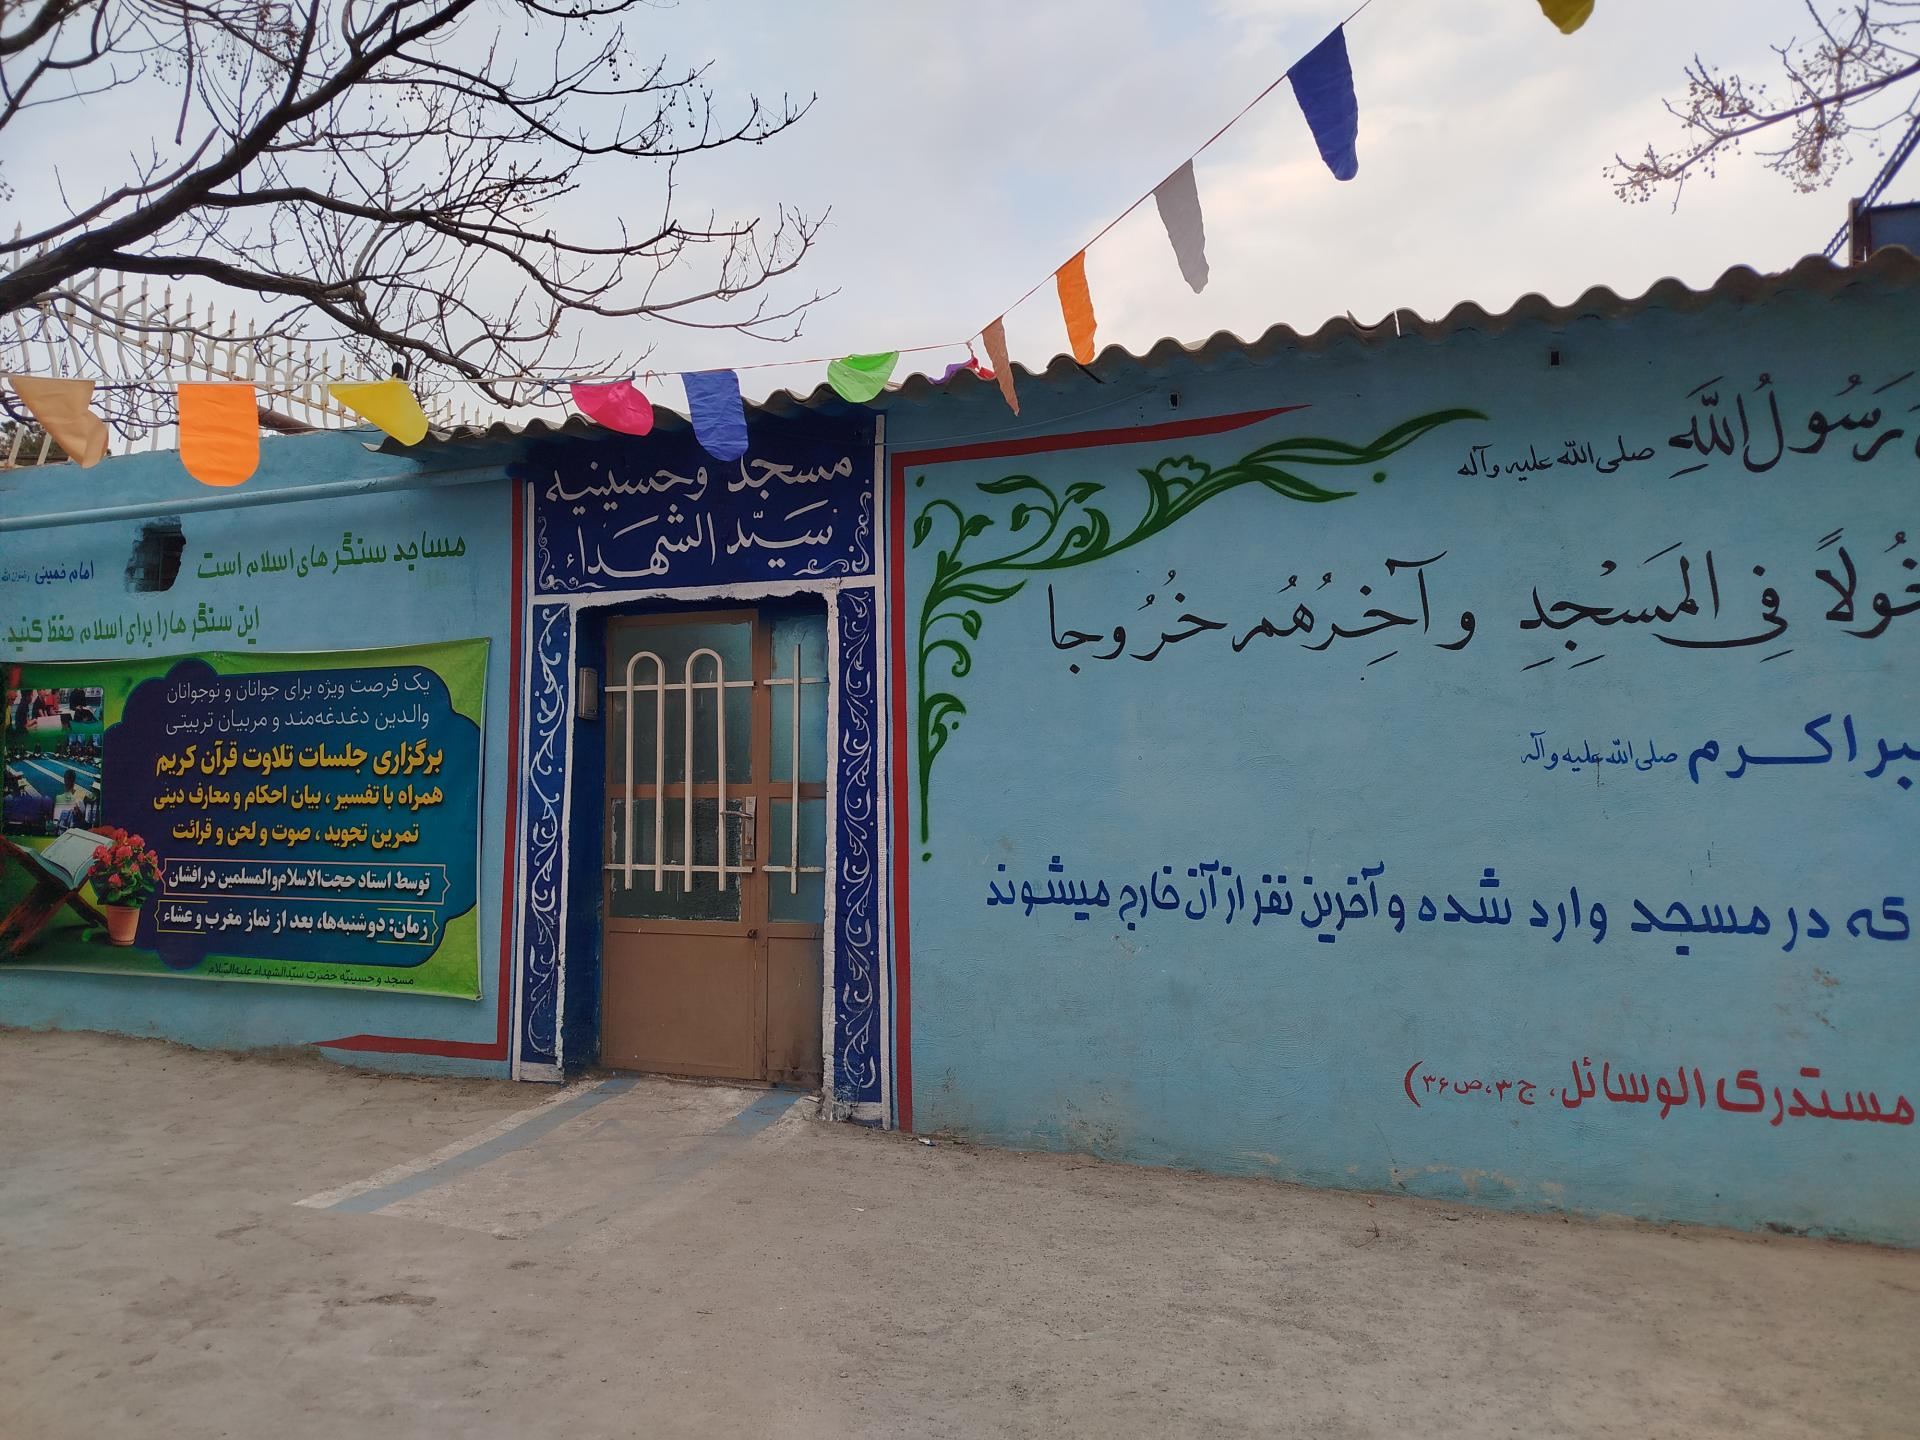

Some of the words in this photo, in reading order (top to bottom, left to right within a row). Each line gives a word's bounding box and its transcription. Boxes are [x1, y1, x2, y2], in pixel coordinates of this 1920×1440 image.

[1504, 444, 1554, 482] علیه
[1596, 434, 1656, 475] صلی
[727, 454, 854, 501] مسجد
[246, 547, 294, 578] اسلام
[393, 530, 466, 573] مساجد
[34, 563, 67, 585] خمینی
[69, 560, 95, 585] امام
[196, 551, 242, 580] است
[47, 613, 76, 644] حفظ
[80, 614, 124, 645] اسلام
[125, 612, 152, 649] برای
[237, 604, 260, 646] این
[166, 682, 221, 705] نوجوانان
[235, 680, 279, 702] جوانان
[284, 677, 312, 701] برای
[317, 683, 345, 702] ویژه
[350, 672, 399, 698] فرصت
[404, 672, 430, 692] یک
[224, 689, 232, 703] و
[166, 712, 214, 735] تربیتی
[217, 709, 267, 733] مربیان
[272, 717, 280, 733] و
[374, 704, 430, 731] والدین
[155, 744, 197, 777] کریم
[200, 739, 238, 777] قرآن
[242, 743, 294, 776] تلاوت
[298, 742, 368, 775] جلسات
[372, 738, 444, 776] برگزاری
[1562, 739, 1604, 774] علیه
[1635, 739, 1679, 772] صلی
[1687, 713, 1858, 785] اکرم
[152, 786, 186, 811] دینی
[188, 783, 231, 809] معارف
[233, 792, 242, 810] و
[244, 784, 288, 812] احکام
[291, 786, 322, 811] بیان
[383, 786, 394, 807] با
[398, 784, 444, 811] همراه
[172, 819, 213, 845] قرائت
[215, 828, 224, 846] و
[227, 820, 257, 846] لحن
[259, 828, 268, 846] و
[272, 823, 312, 848] صوت
[371, 821, 419, 849] تمرین
[358, 869, 392, 889] استاد
[394, 870, 431, 896] توسط
[986, 855, 1112, 922] میشوند
[1185, 859, 1220, 922] آن
[1118, 865, 1182, 933] خارج
[1221, 866, 1246, 926] از
[1252, 873, 1294, 928] نفر
[1300, 859, 1386, 944] آخرین
[1417, 867, 1513, 926] شده
[163, 905, 193, 923] عشاء
[194, 913, 202, 930] و
[204, 907, 242, 931] مغرب
[244, 908, 271, 932] نماز
[272, 908, 288, 934] از
[289, 914, 314, 934] بعد
[388, 913, 429, 941] زمان:
[1388, 893, 1407, 935] و
[1528, 886, 1609, 945] وارد
[1630, 898, 1771, 956] مسجد
[1846, 896, 1911, 942] که
[1781, 907, 1831, 953] در
[306, 969, 338, 985] حضرت
[384, 975, 415, 988] مسجد
[1715, 1066, 1917, 1127] مستدرک
